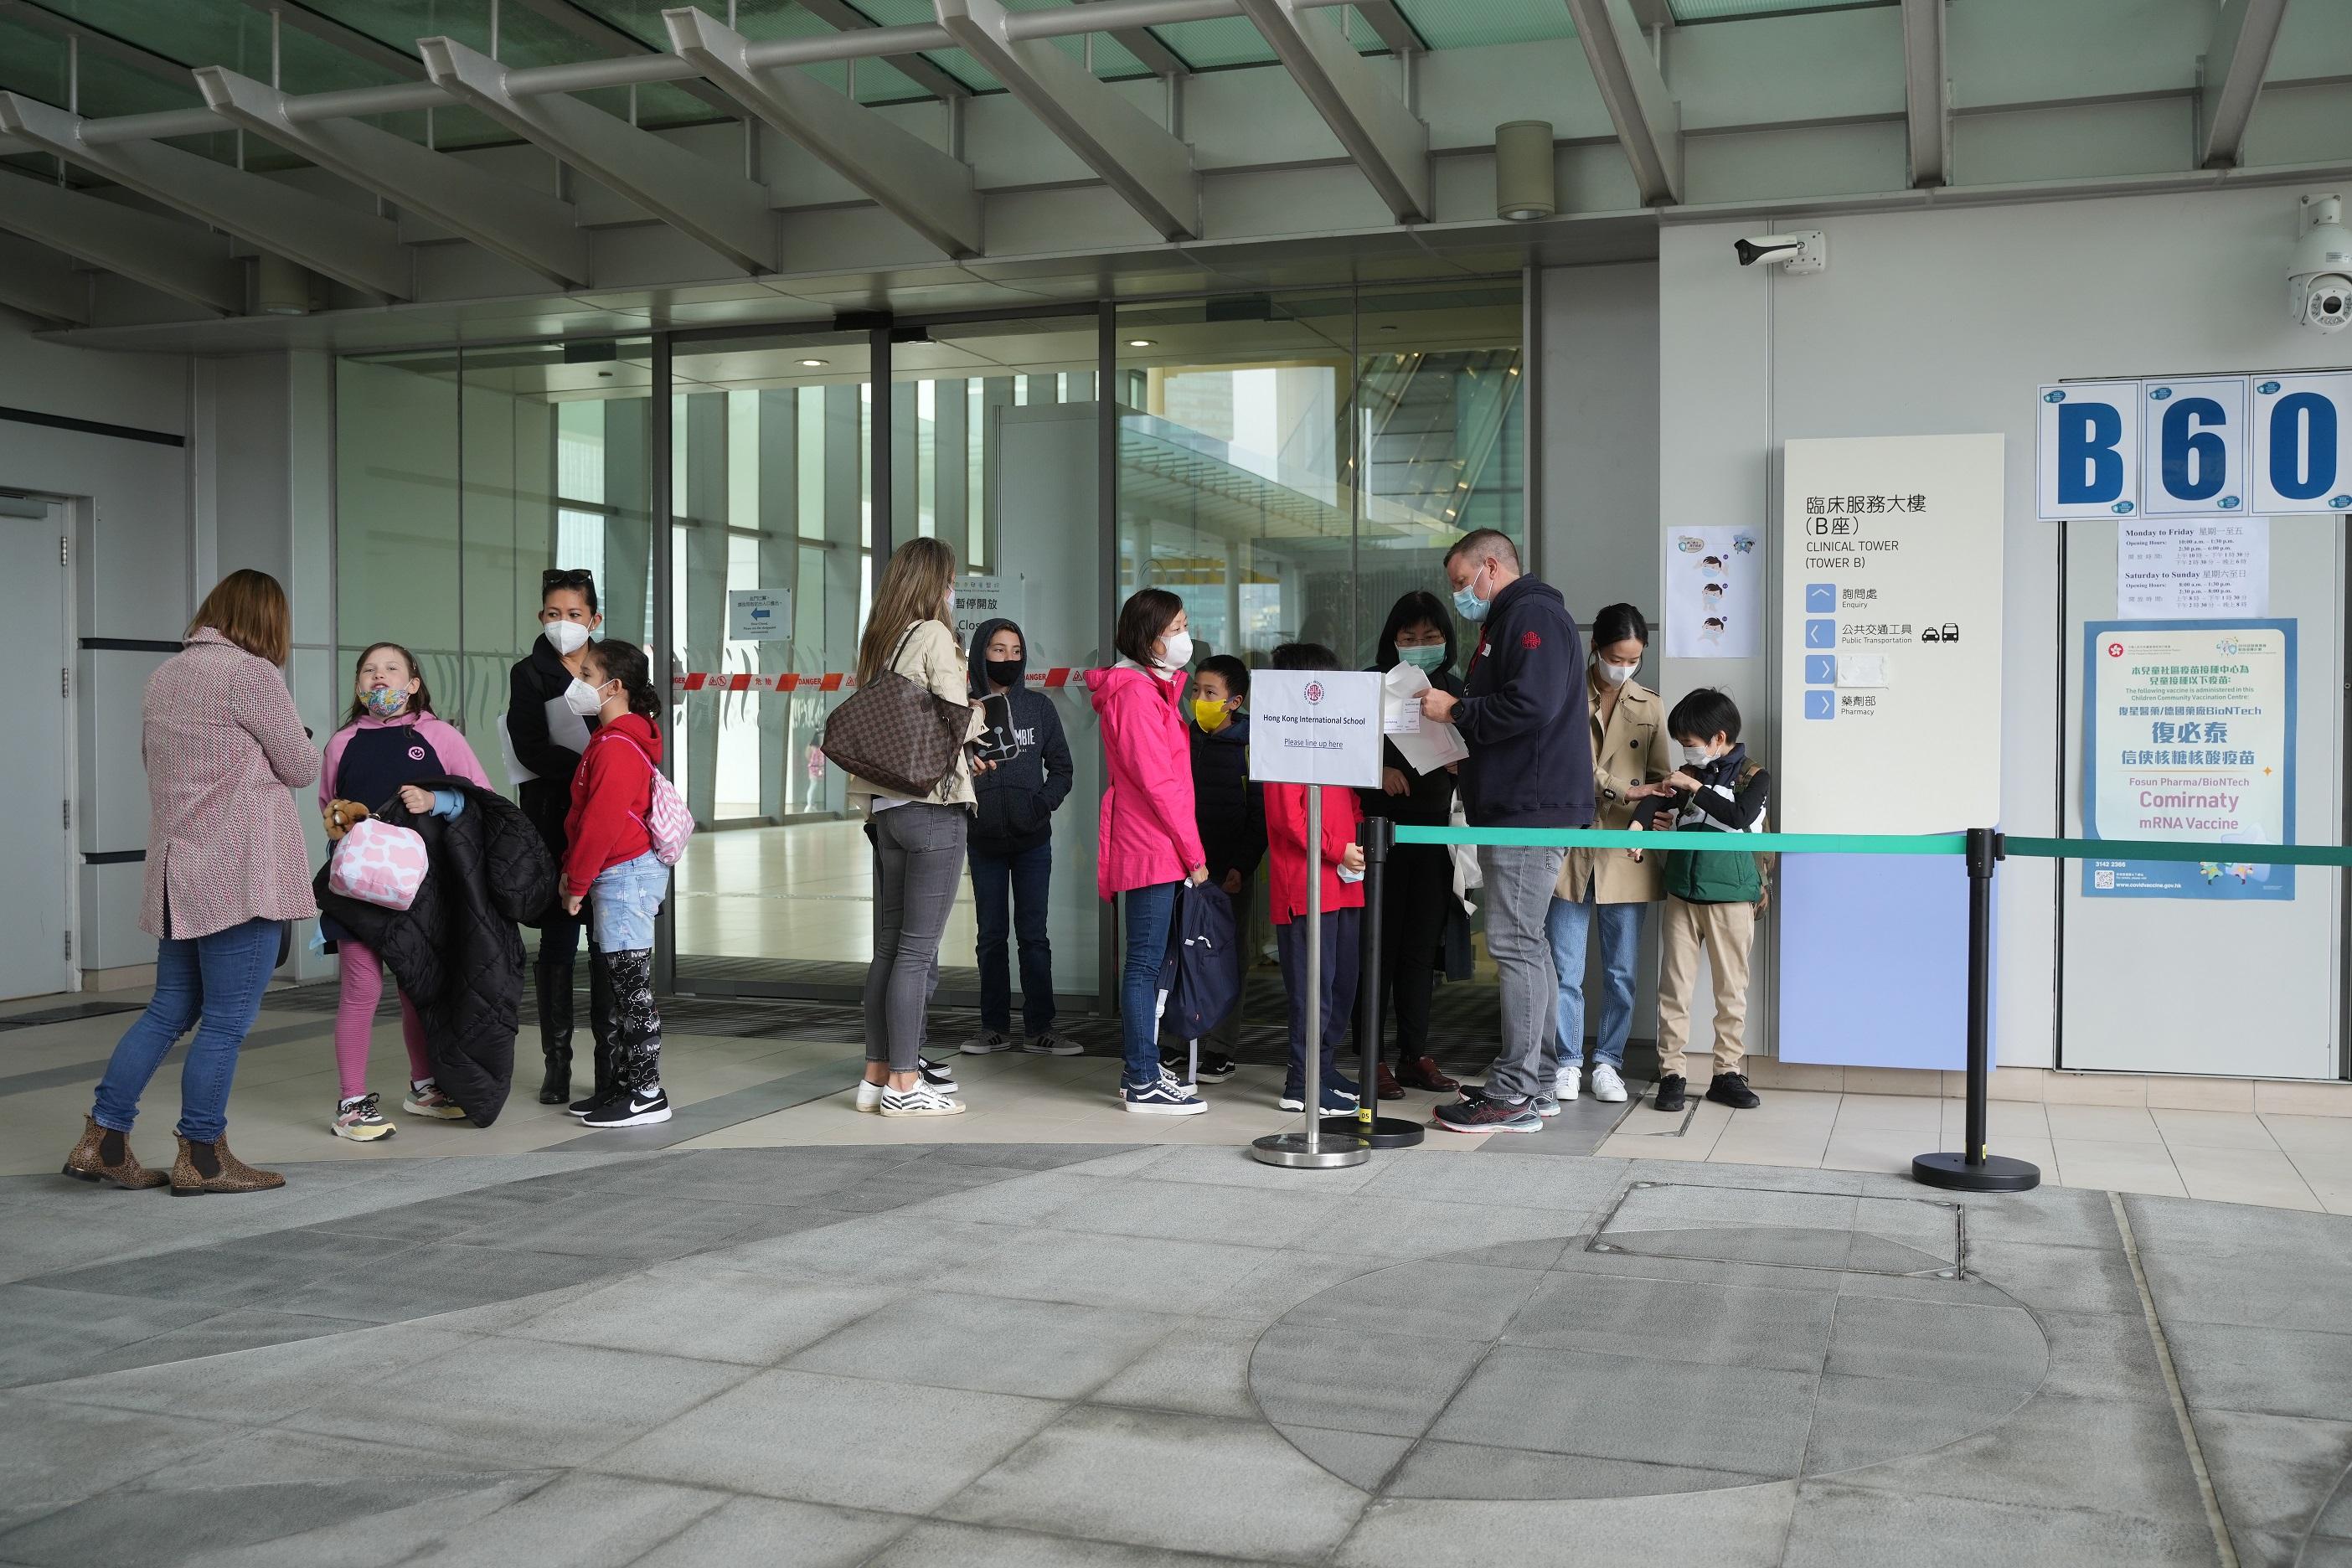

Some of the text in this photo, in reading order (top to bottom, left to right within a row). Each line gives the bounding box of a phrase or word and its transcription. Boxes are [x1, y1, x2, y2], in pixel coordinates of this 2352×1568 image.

[1807, 493, 1926, 514] 臨床服務大樓
[2169, 529, 2195, 537] Friday
[2199, 527, 2245, 536] 星期一至五
[1807, 540, 1899, 552] CLINICAL TOWER
[1806, 556, 1865, 569] (TOWER B)
[2125, 571, 2160, 580] Saturday
[2171, 570, 2200, 580] Sunday
[2203, 570, 2246, 579] 星期六至日
[1842, 588, 1878, 600] 詢問處
[955, 598, 998, 610] 暫停開放
[958, 619, 981, 631] Clos
[1842, 623, 1912, 636] 公共交通工具
[2132, 664, 2250, 675] 本兒童社區疫苗接種中心為
[1841, 695, 1876, 707] 藥劑部
[1263, 714, 1365, 725] Hong Kong International School
[1014, 727, 1035, 745] MBIE
[2152, 721, 2228, 744] 復必泰
[1284, 738, 1344, 749] Please line up here
[2121, 750, 2255, 765] 信使核糖核酸疫苗
[2129, 777, 2250, 787] Fosun Pharma/BioNTech
[2139, 790, 2239, 813] Comirnaty
[2139, 816, 2239, 830] mRNA Vaccine
